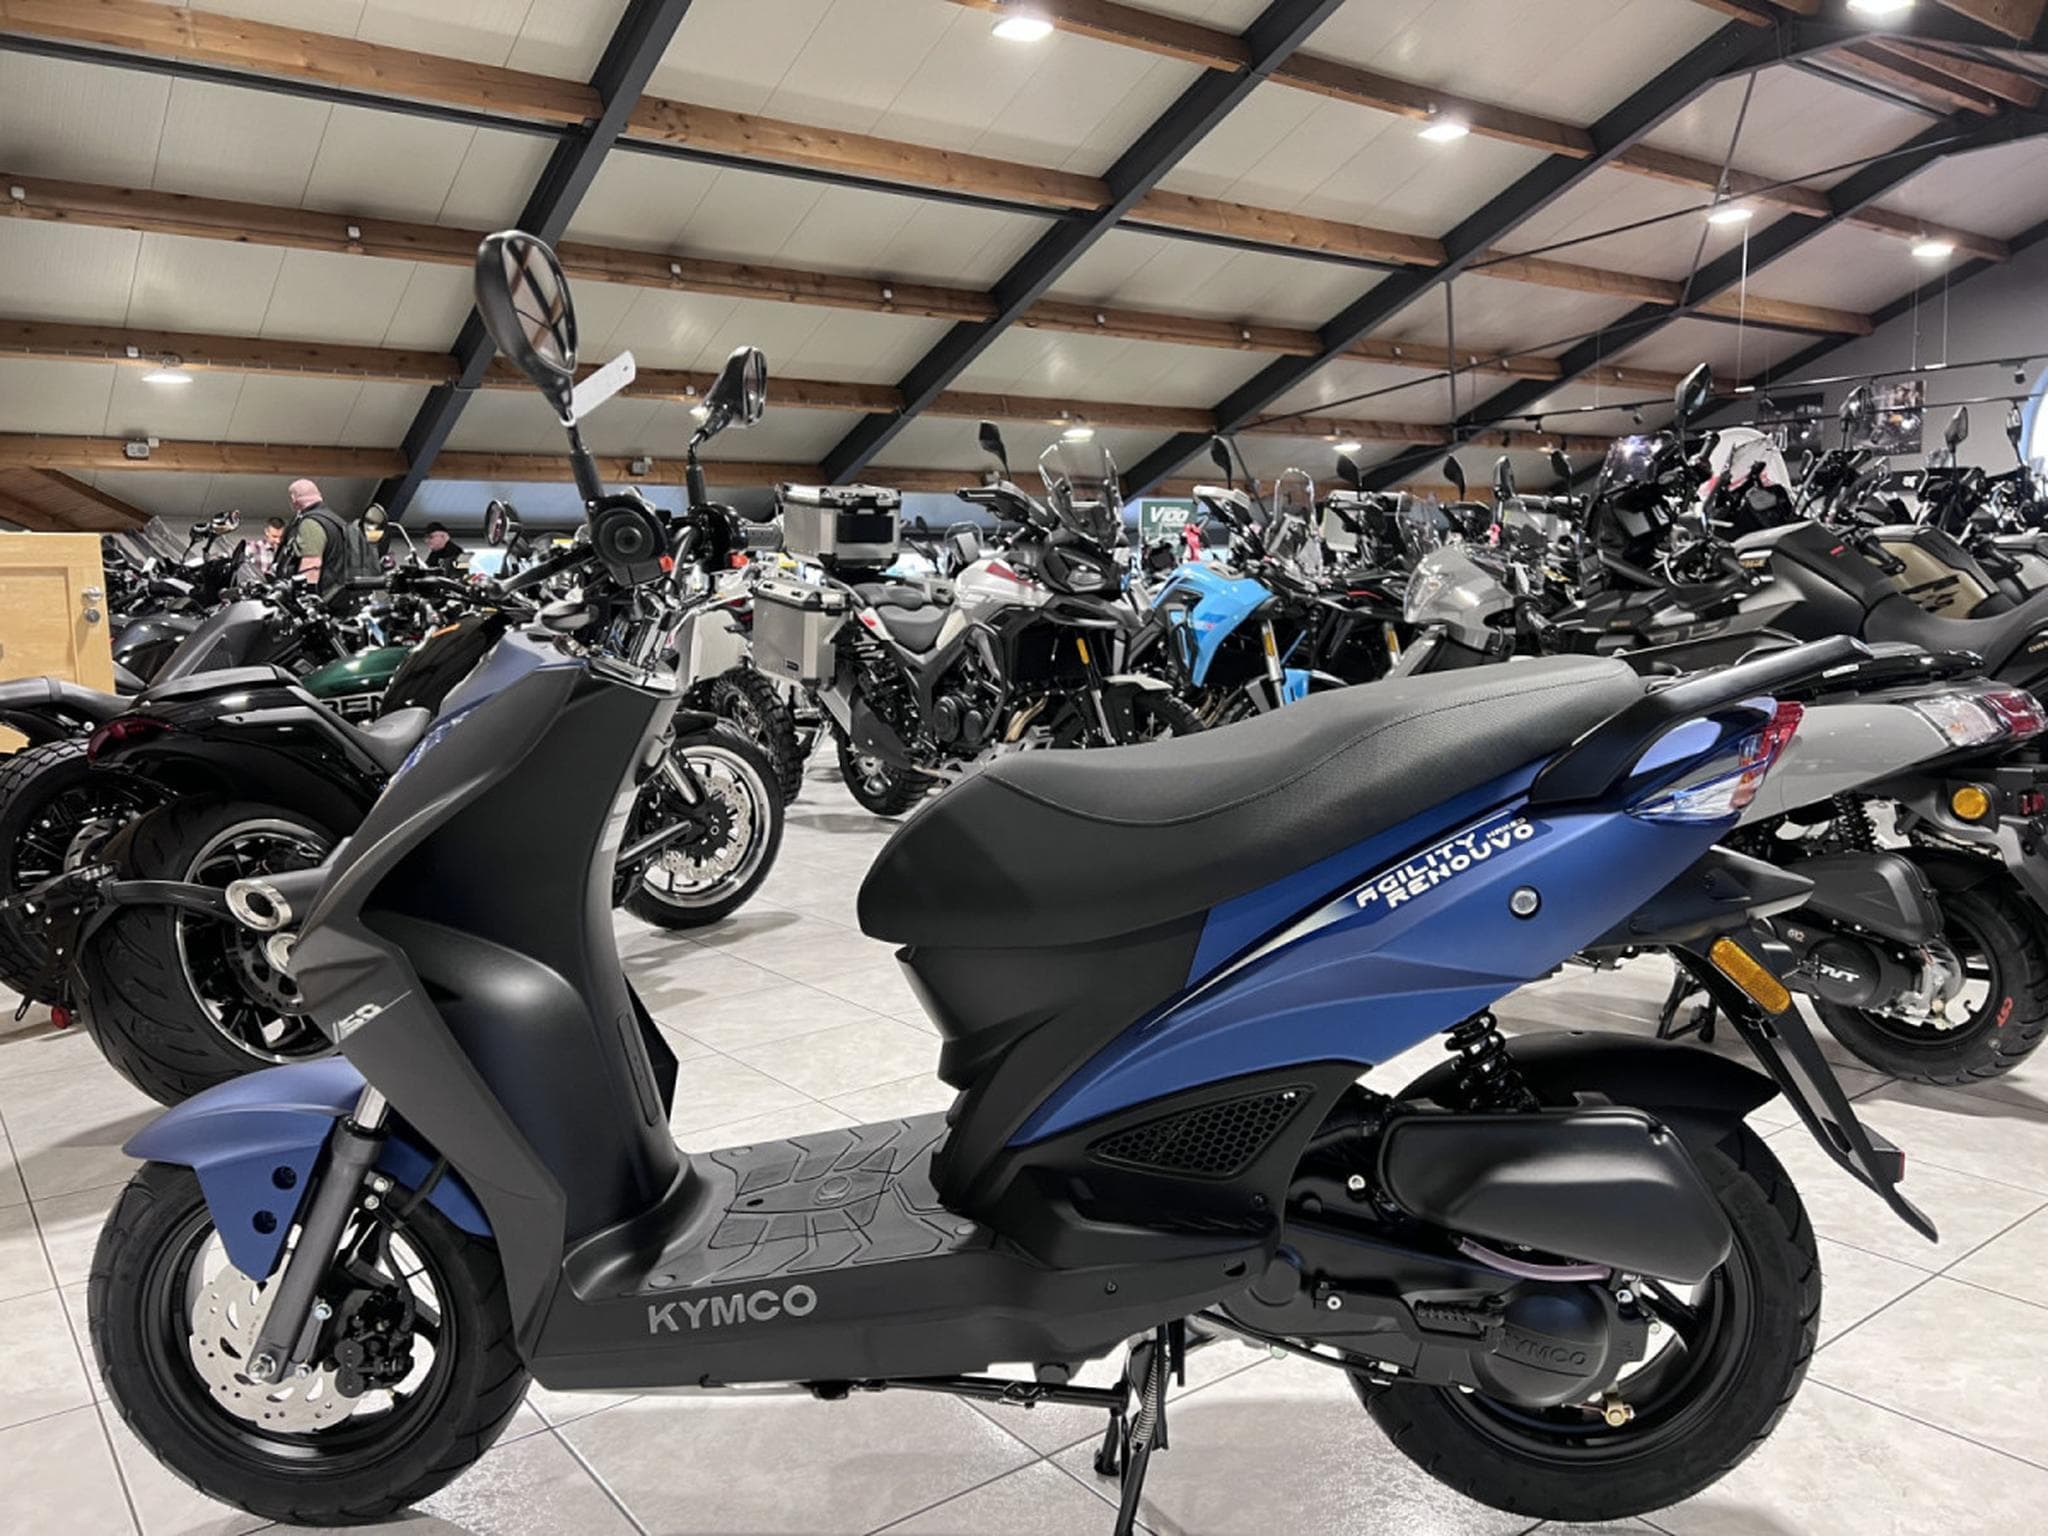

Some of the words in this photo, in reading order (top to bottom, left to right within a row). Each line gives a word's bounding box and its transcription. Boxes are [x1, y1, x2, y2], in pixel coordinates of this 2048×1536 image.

[1356, 832, 1475, 908] AGILITY
[1386, 823, 1534, 909] RENOUVO
[647, 1284, 817, 1334] KYMCO
